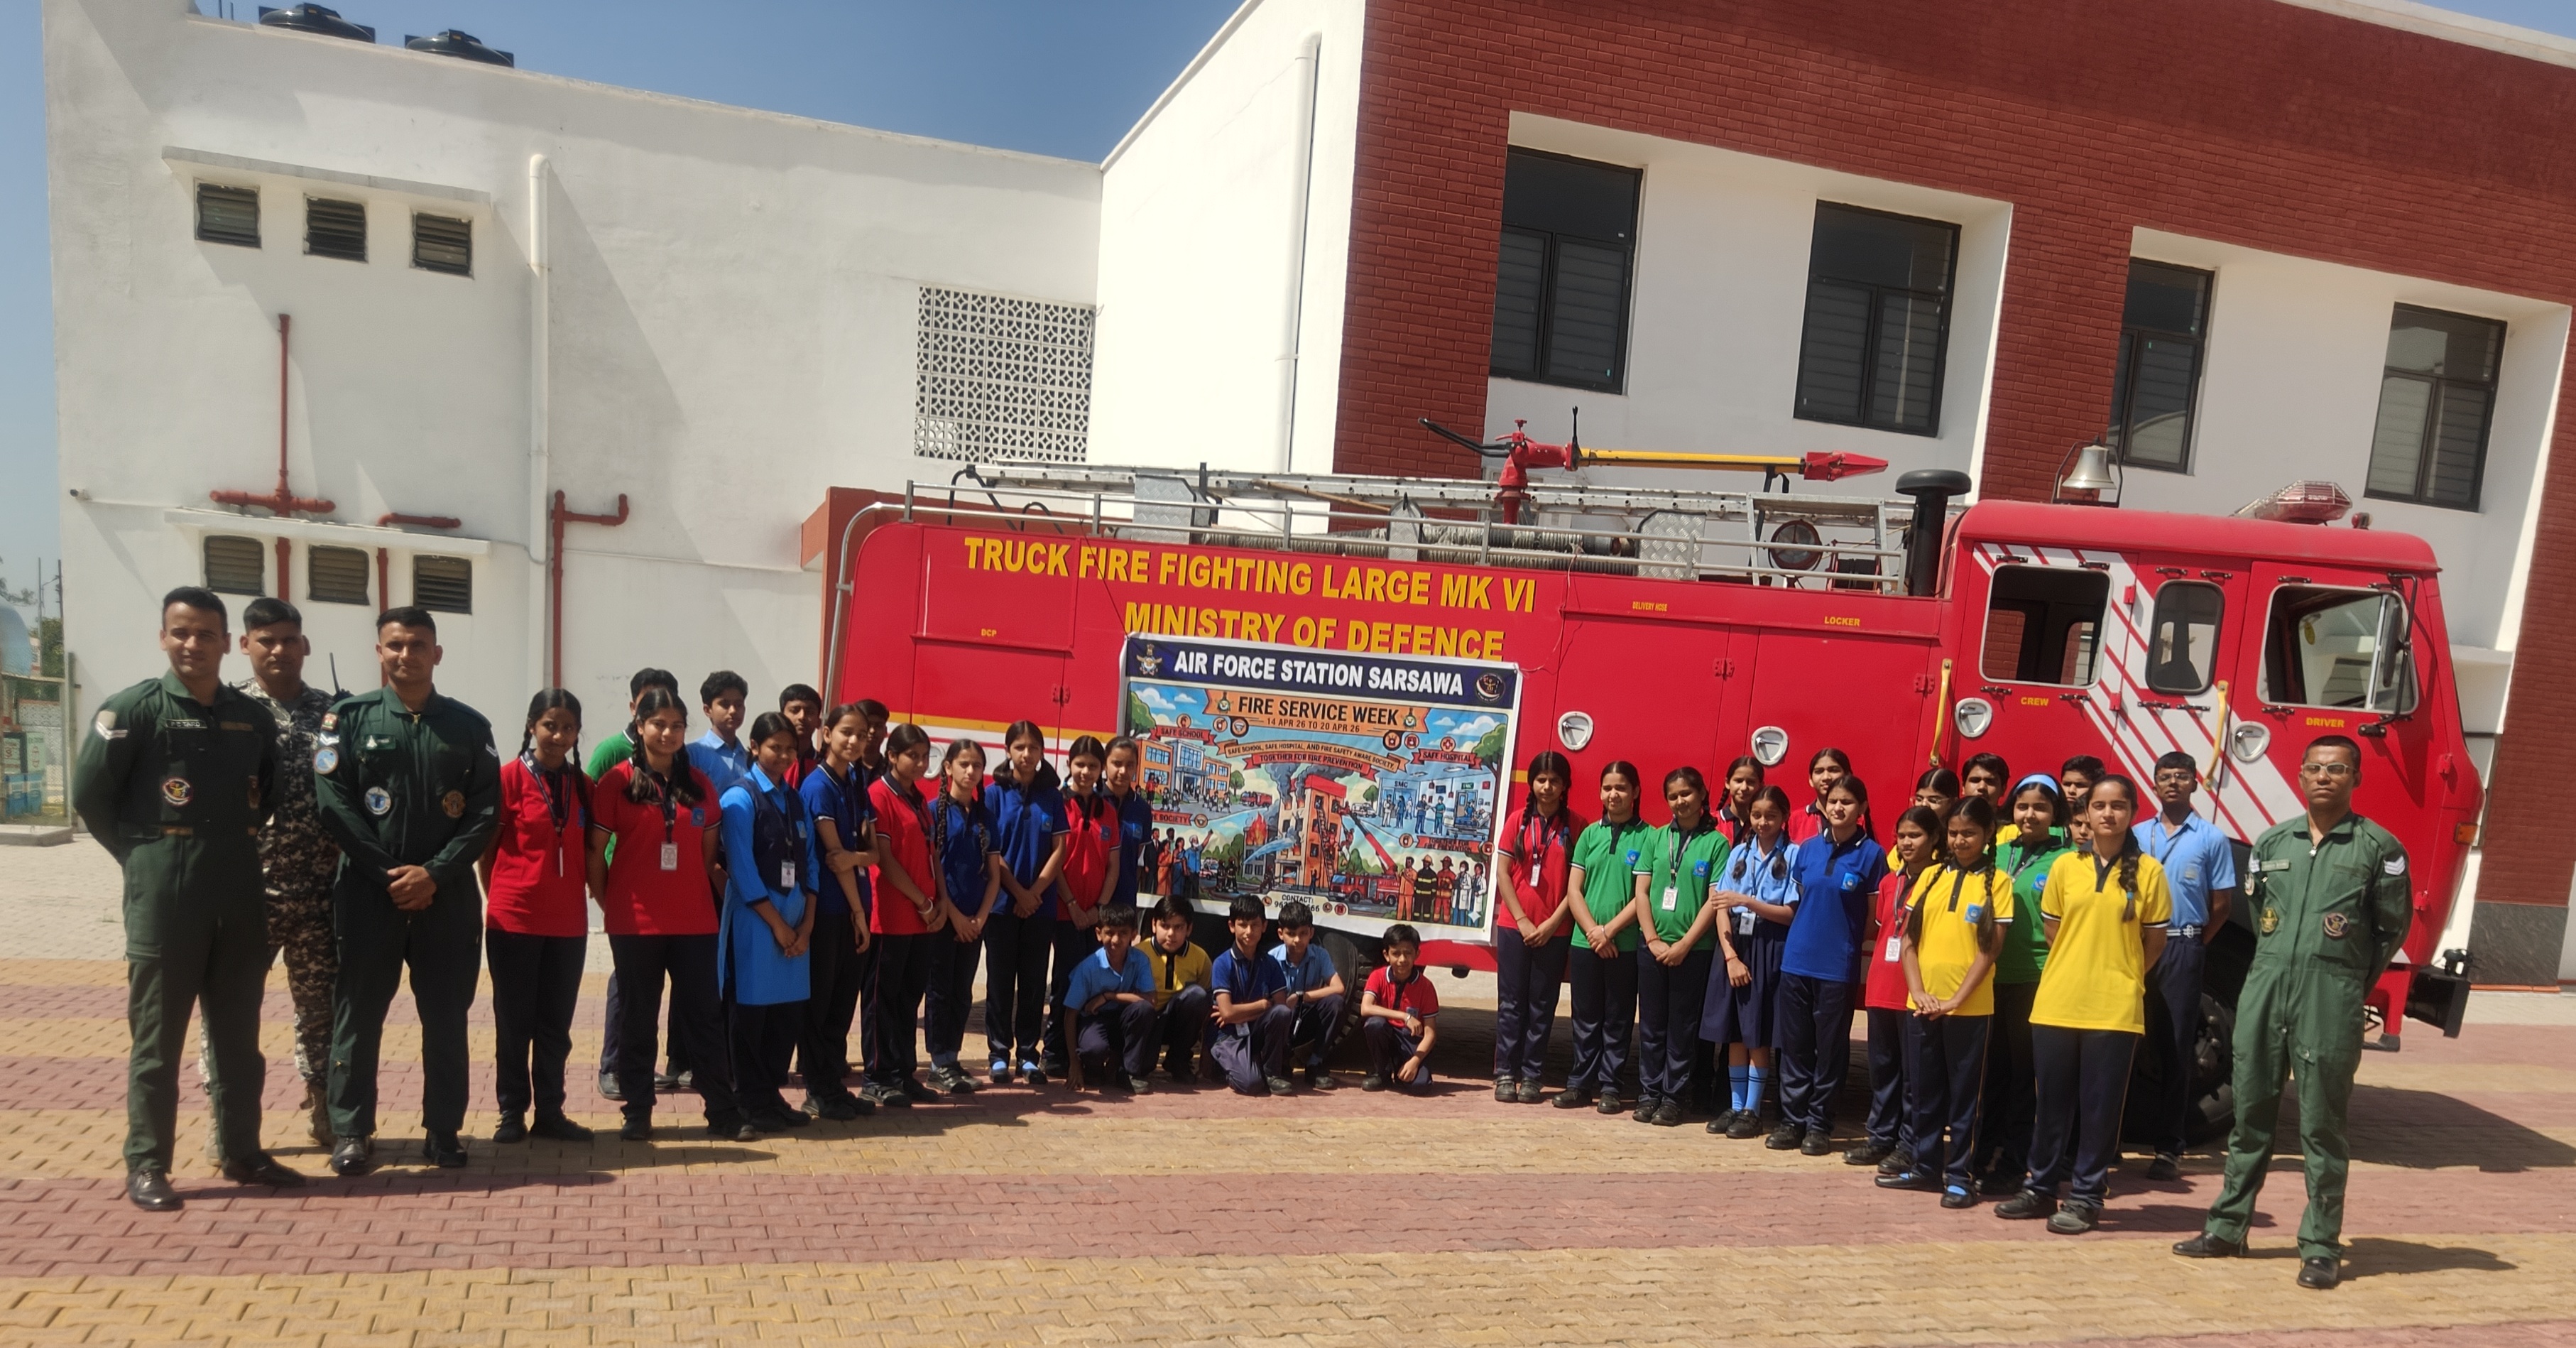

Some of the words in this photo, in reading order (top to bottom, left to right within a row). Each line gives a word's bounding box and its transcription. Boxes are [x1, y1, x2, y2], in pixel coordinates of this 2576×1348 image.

[964, 537, 1071, 577] TRUCK
[1079, 545, 1150, 583] FIRE
[1159, 552, 1312, 596] FIGHTING
[1322, 565, 1431, 605] LARGE
[1440, 573, 1494, 610] MK
[1503, 577, 1537, 612] VI
[1632, 601, 1654, 610] DELIVERY
[1655, 602, 1667, 612] HOSE
[1824, 616, 1860, 626] LOCKER
[981, 629, 997, 637] DCP
[1124, 602, 1285, 643] MINISTRY
[1292, 616, 1337, 649] OF
[1347, 620, 1505, 662] DEFENCE
[1174, 651, 1208, 675] AIR
[1213, 653, 1276, 680] FORCE
[1280, 659, 1363, 688] STATION
[1368, 666, 1463, 696] SARSAWA
[2021, 697, 2049, 707] CREW
[1238, 696, 1274, 715] FIRE
[1278, 700, 1348, 722] SERVICE
[1353, 706, 1399, 726] WEEK
[1278, 718, 1294, 727] APR
[1296, 719, 1306, 729] 26
[1309, 721, 1318, 729] TO
[1320, 722, 1330, 731] 20
[1332, 723, 1348, 732] APR
[1350, 724, 1360, 733] 26
[2306, 717, 2345, 728] DRIVER
[1161, 728, 1177, 736] SAFE
[1178, 730, 1204, 739] SCHOOL
[1333, 747, 1352, 757] SAFETY
[1353, 751, 1371, 762] AWARE
[1422, 751, 1439, 760] SAFE
[1441, 753, 1471, 762] HOSPITAL
[1323, 756, 1363, 771] PREVENTION
[1159, 814, 1188, 823] SOCIETY
